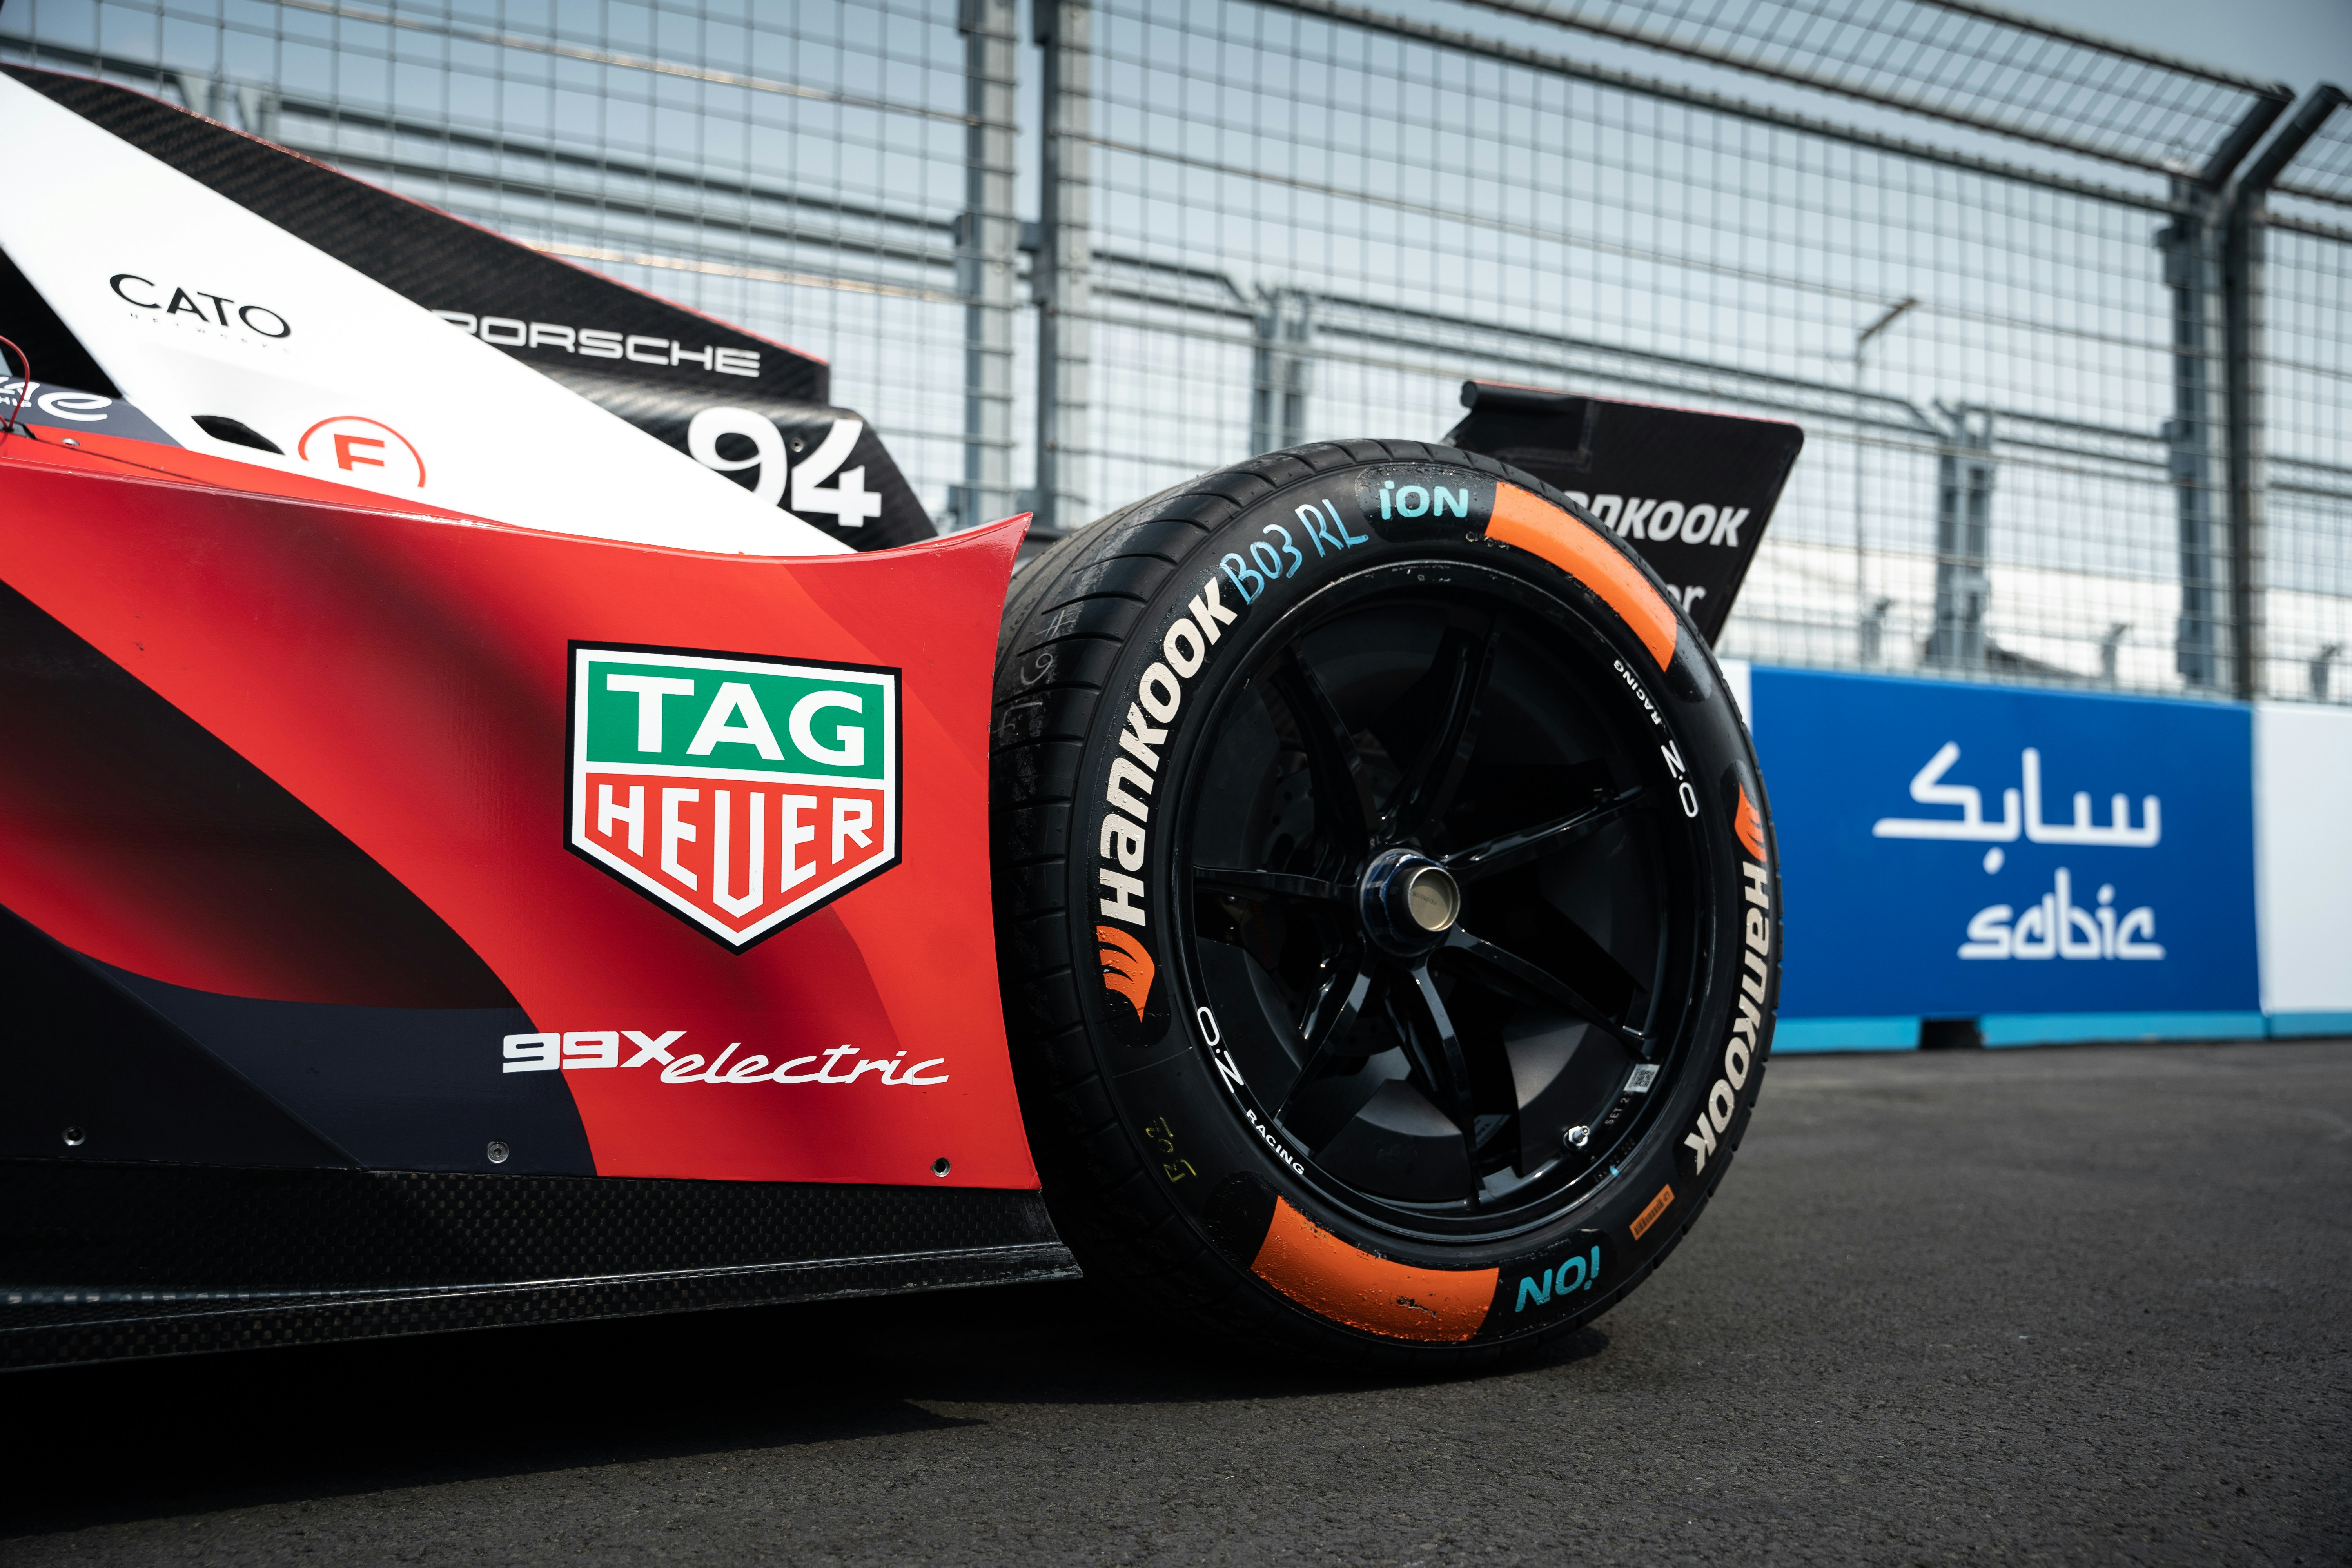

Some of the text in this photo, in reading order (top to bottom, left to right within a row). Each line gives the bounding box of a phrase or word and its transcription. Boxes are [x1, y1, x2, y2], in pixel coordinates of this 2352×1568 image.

[110, 274, 291, 338] CATO
[688, 406, 882, 527] 94
[1220, 498, 1369, 605] B03 RL
[607, 674, 864, 766] TAG
[1613, 659, 1659, 725] RACING
[598, 784, 873, 918] HEUER
[1957, 866, 2167, 960] sabic
[660, 1042, 949, 1086] electric
[1246, 1109, 1304, 1175] RACING
[1604, 1107, 1622, 1125] SET
